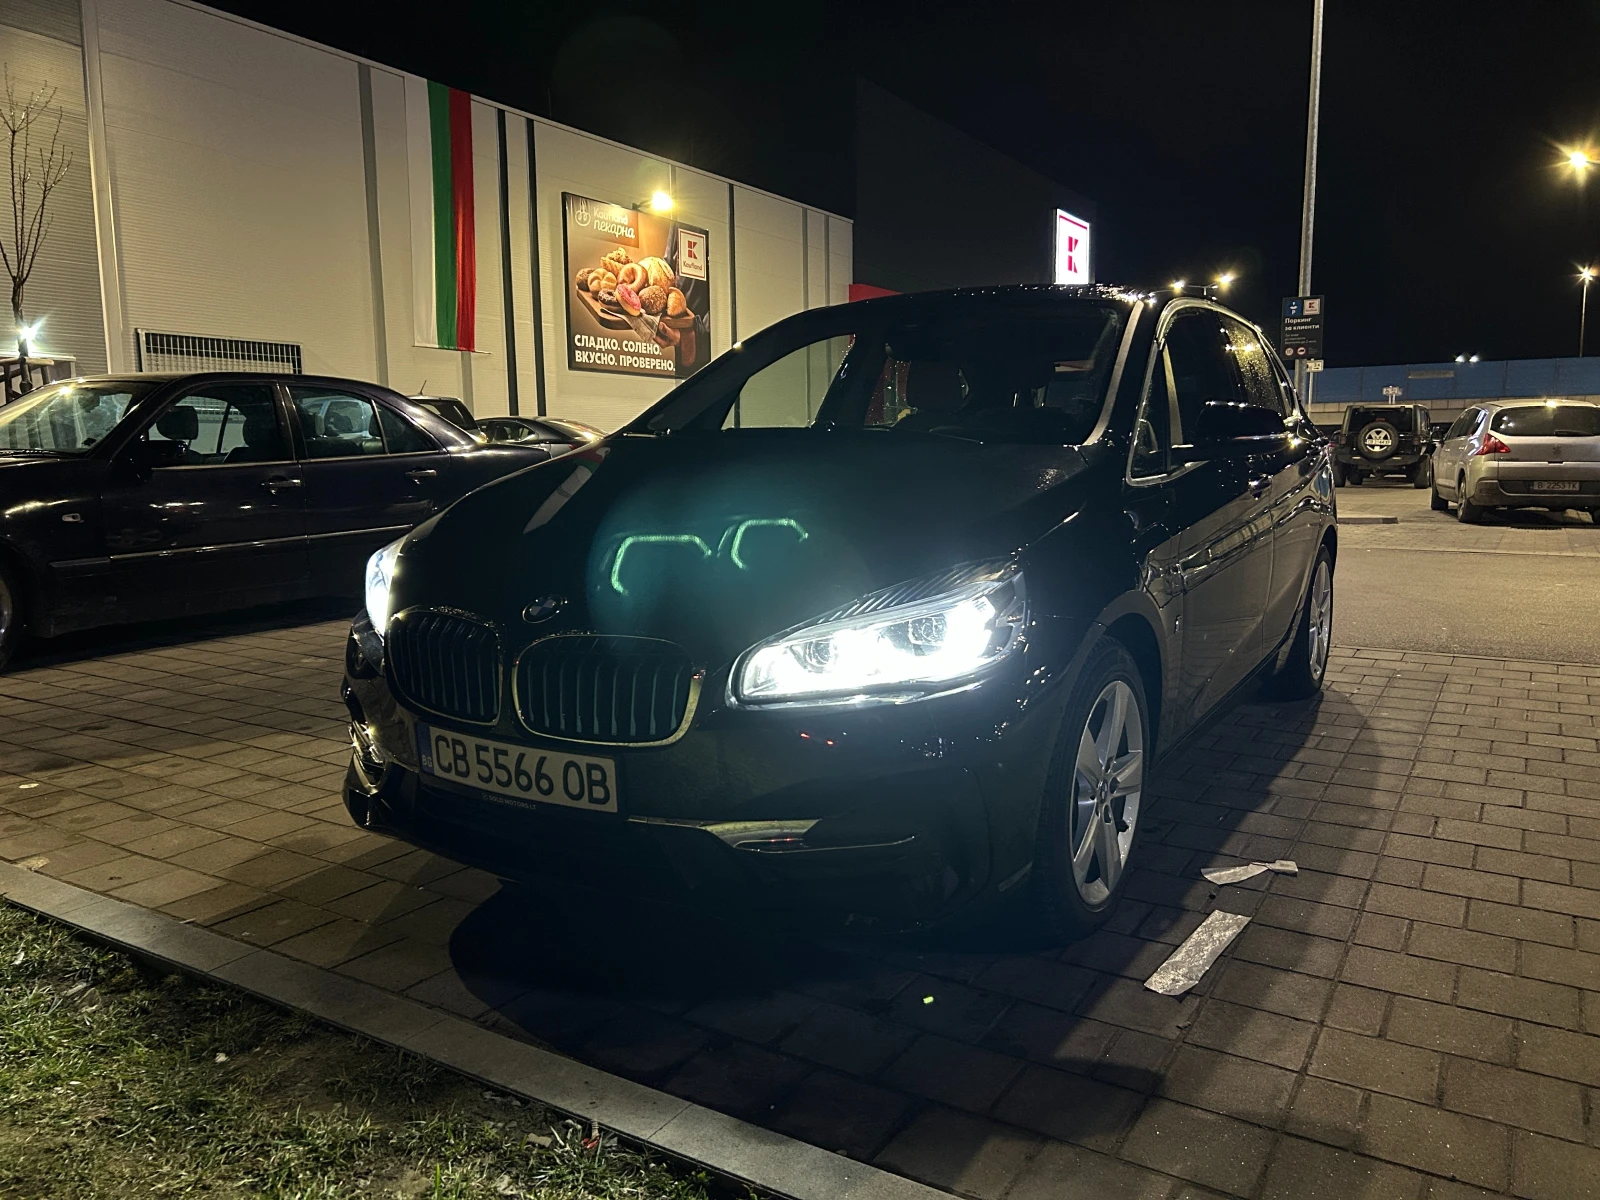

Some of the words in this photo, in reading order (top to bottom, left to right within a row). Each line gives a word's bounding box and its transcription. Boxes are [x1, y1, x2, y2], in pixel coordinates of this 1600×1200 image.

[593, 219, 636, 239] пекарна
[687, 240, 698, 260] K
[1067, 235, 1079, 274] K
[574, 334, 621, 352] СЛАДКО.
[622, 340, 662, 356] СОЛЕНО.
[575, 350, 618, 366] ВКУСНО.
[619, 355, 676, 372] ПРОВЕРЕНО.
[1537, 481, 1543, 489] B
[421, 754, 433, 768] BG
[434, 735, 470, 778] CB
[475, 743, 554, 797] 5566
[562, 760, 611, 805] OB
